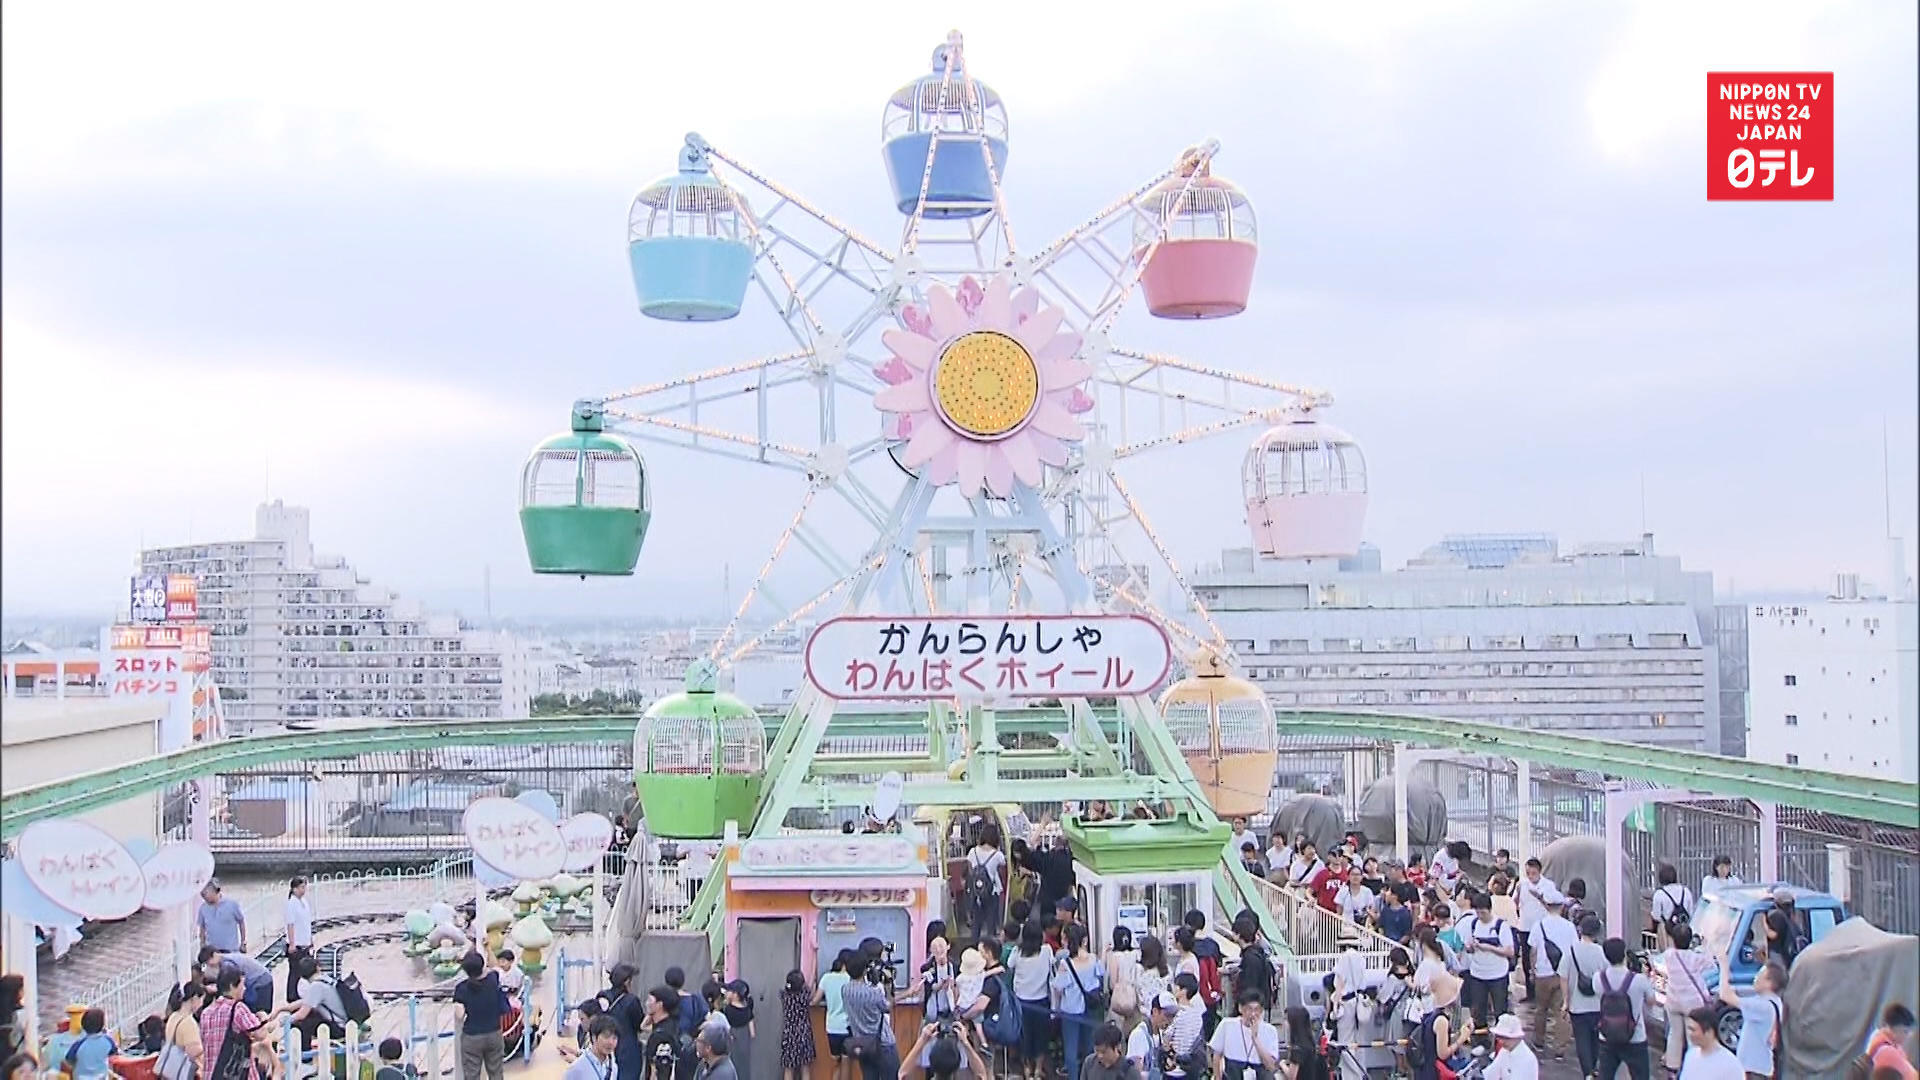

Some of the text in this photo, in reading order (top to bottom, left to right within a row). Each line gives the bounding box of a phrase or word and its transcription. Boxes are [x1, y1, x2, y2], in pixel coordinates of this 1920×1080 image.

[878, 622, 1102, 655] かんらんしゃ
[115, 656, 177, 672] スロット
[114, 679, 178, 694] パチンコ
